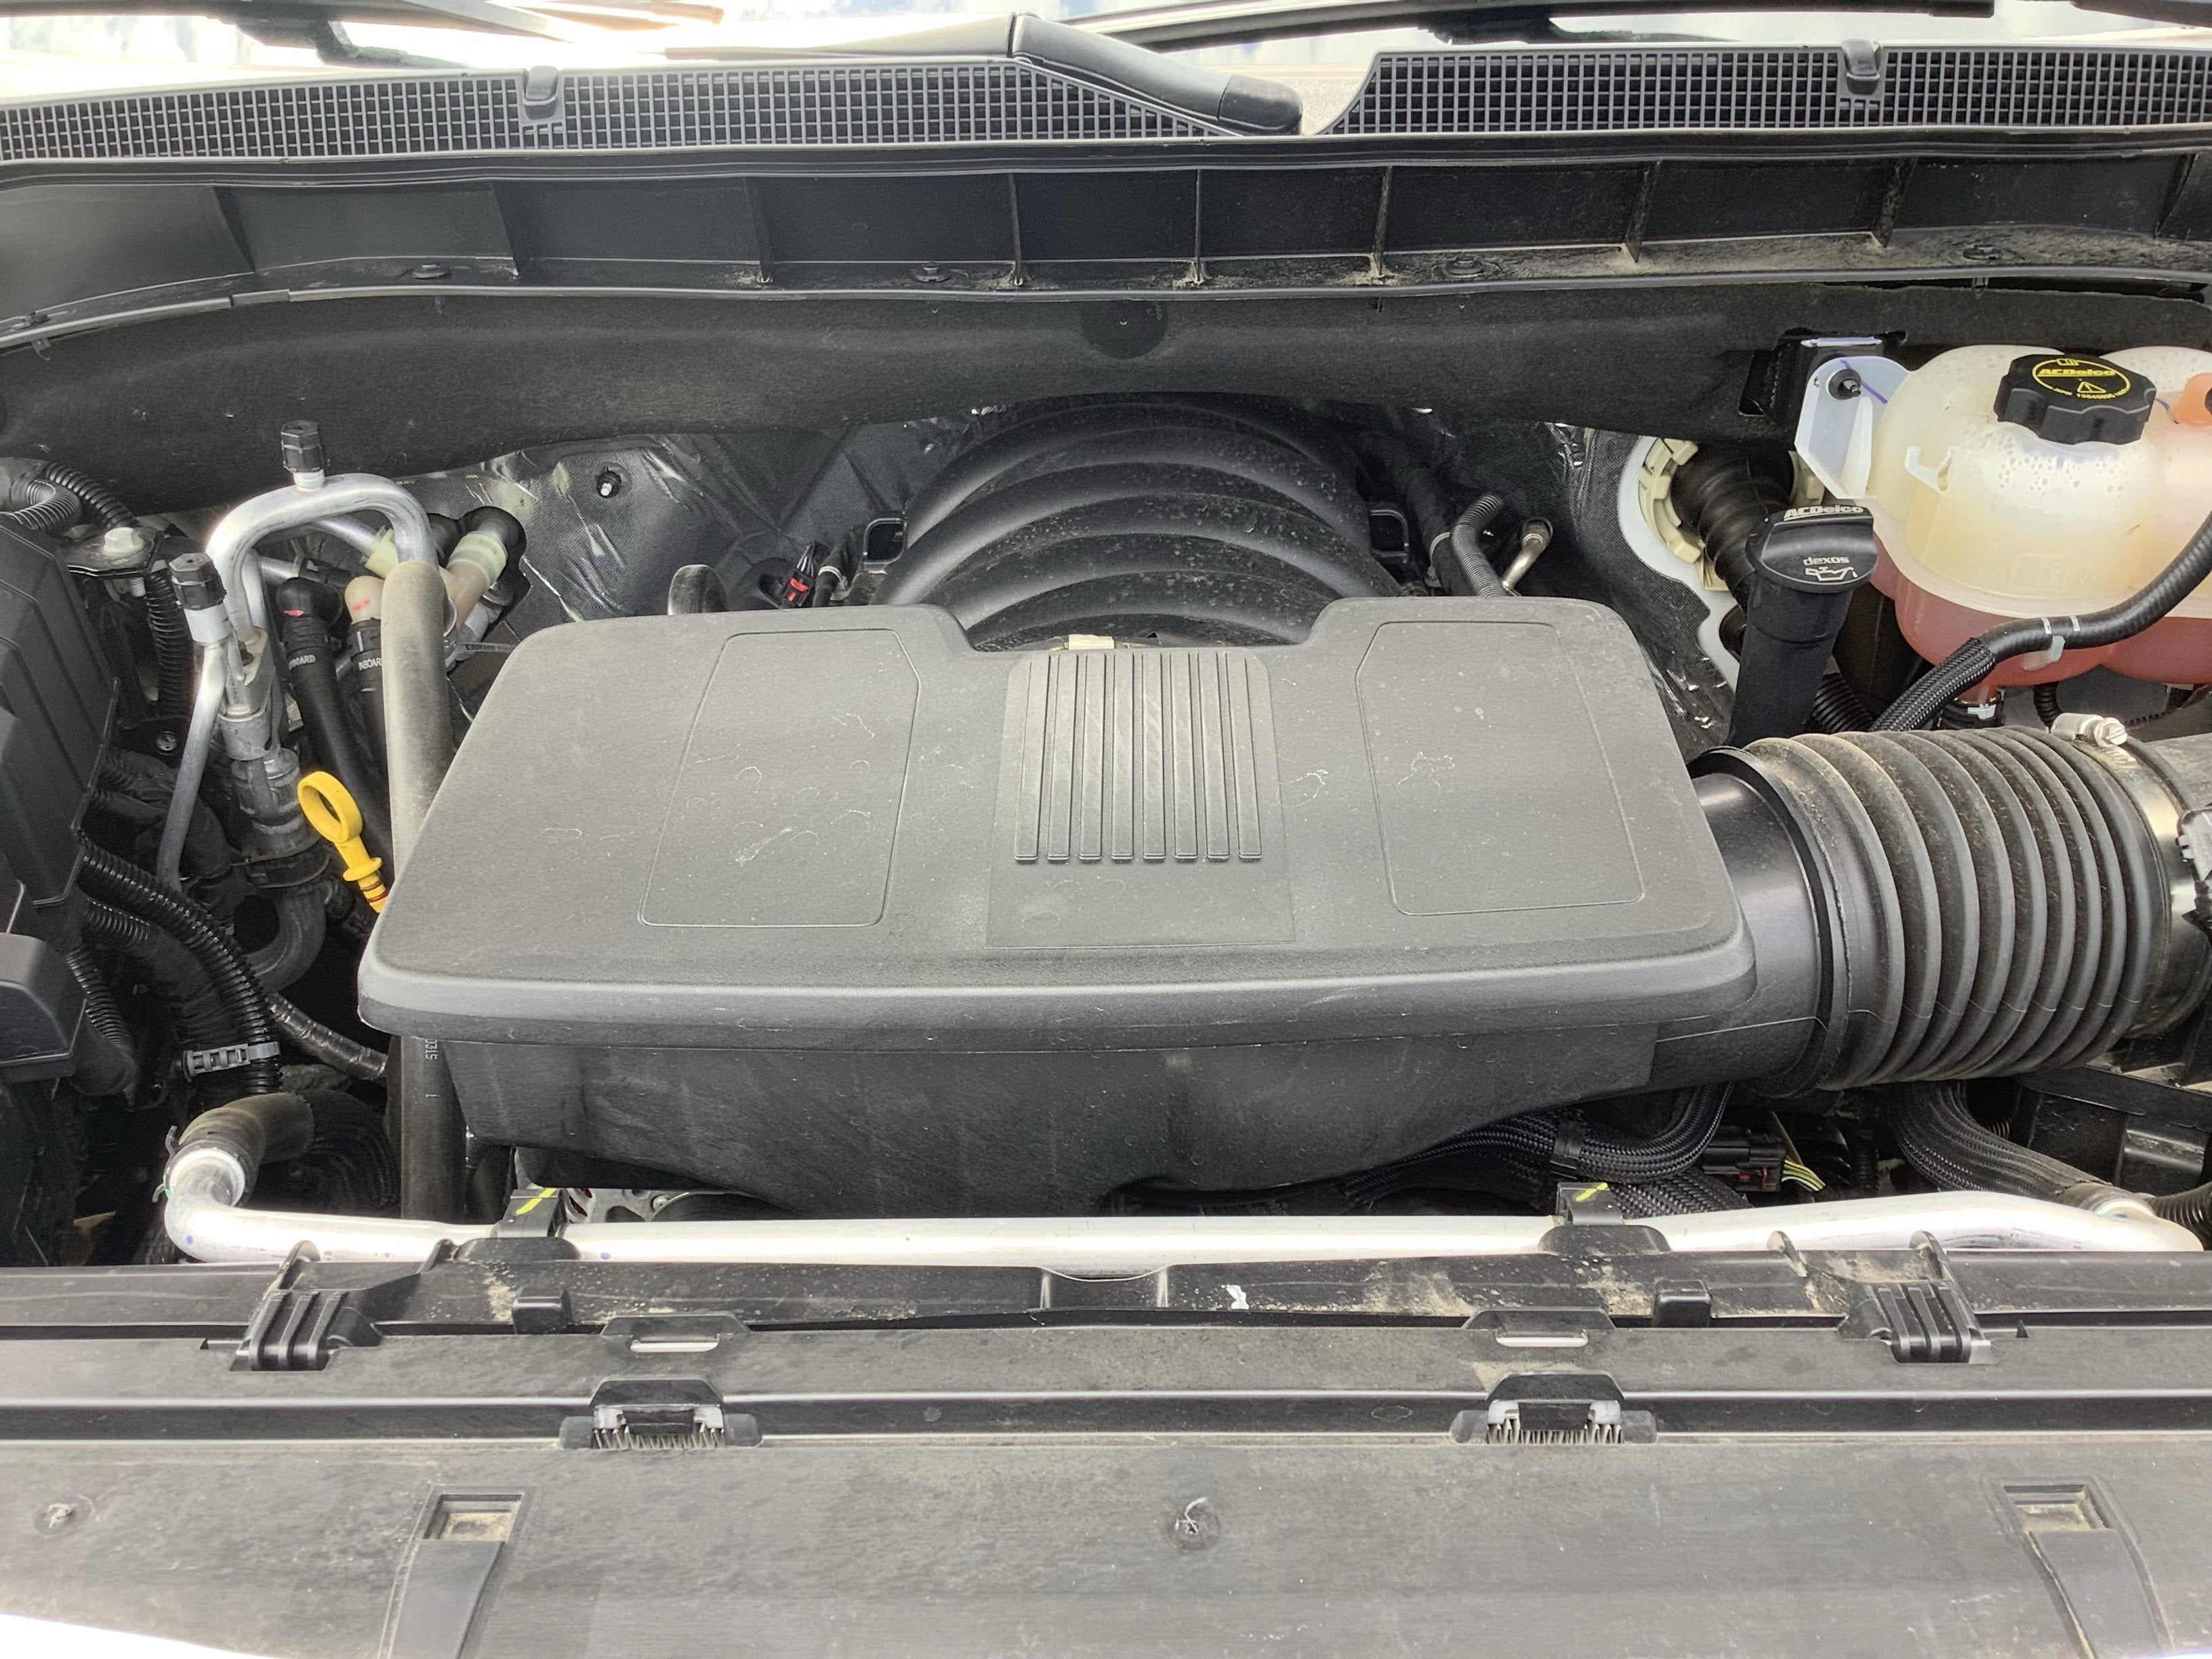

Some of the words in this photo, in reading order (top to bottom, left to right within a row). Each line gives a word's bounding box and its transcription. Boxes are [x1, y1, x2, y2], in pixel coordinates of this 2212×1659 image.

[2038, 368, 2115, 377] ACDelco
[1783, 504, 1864, 520] ACDelco
[1803, 556, 1850, 566] dexos
[358, 657, 383, 671] INBOAR
